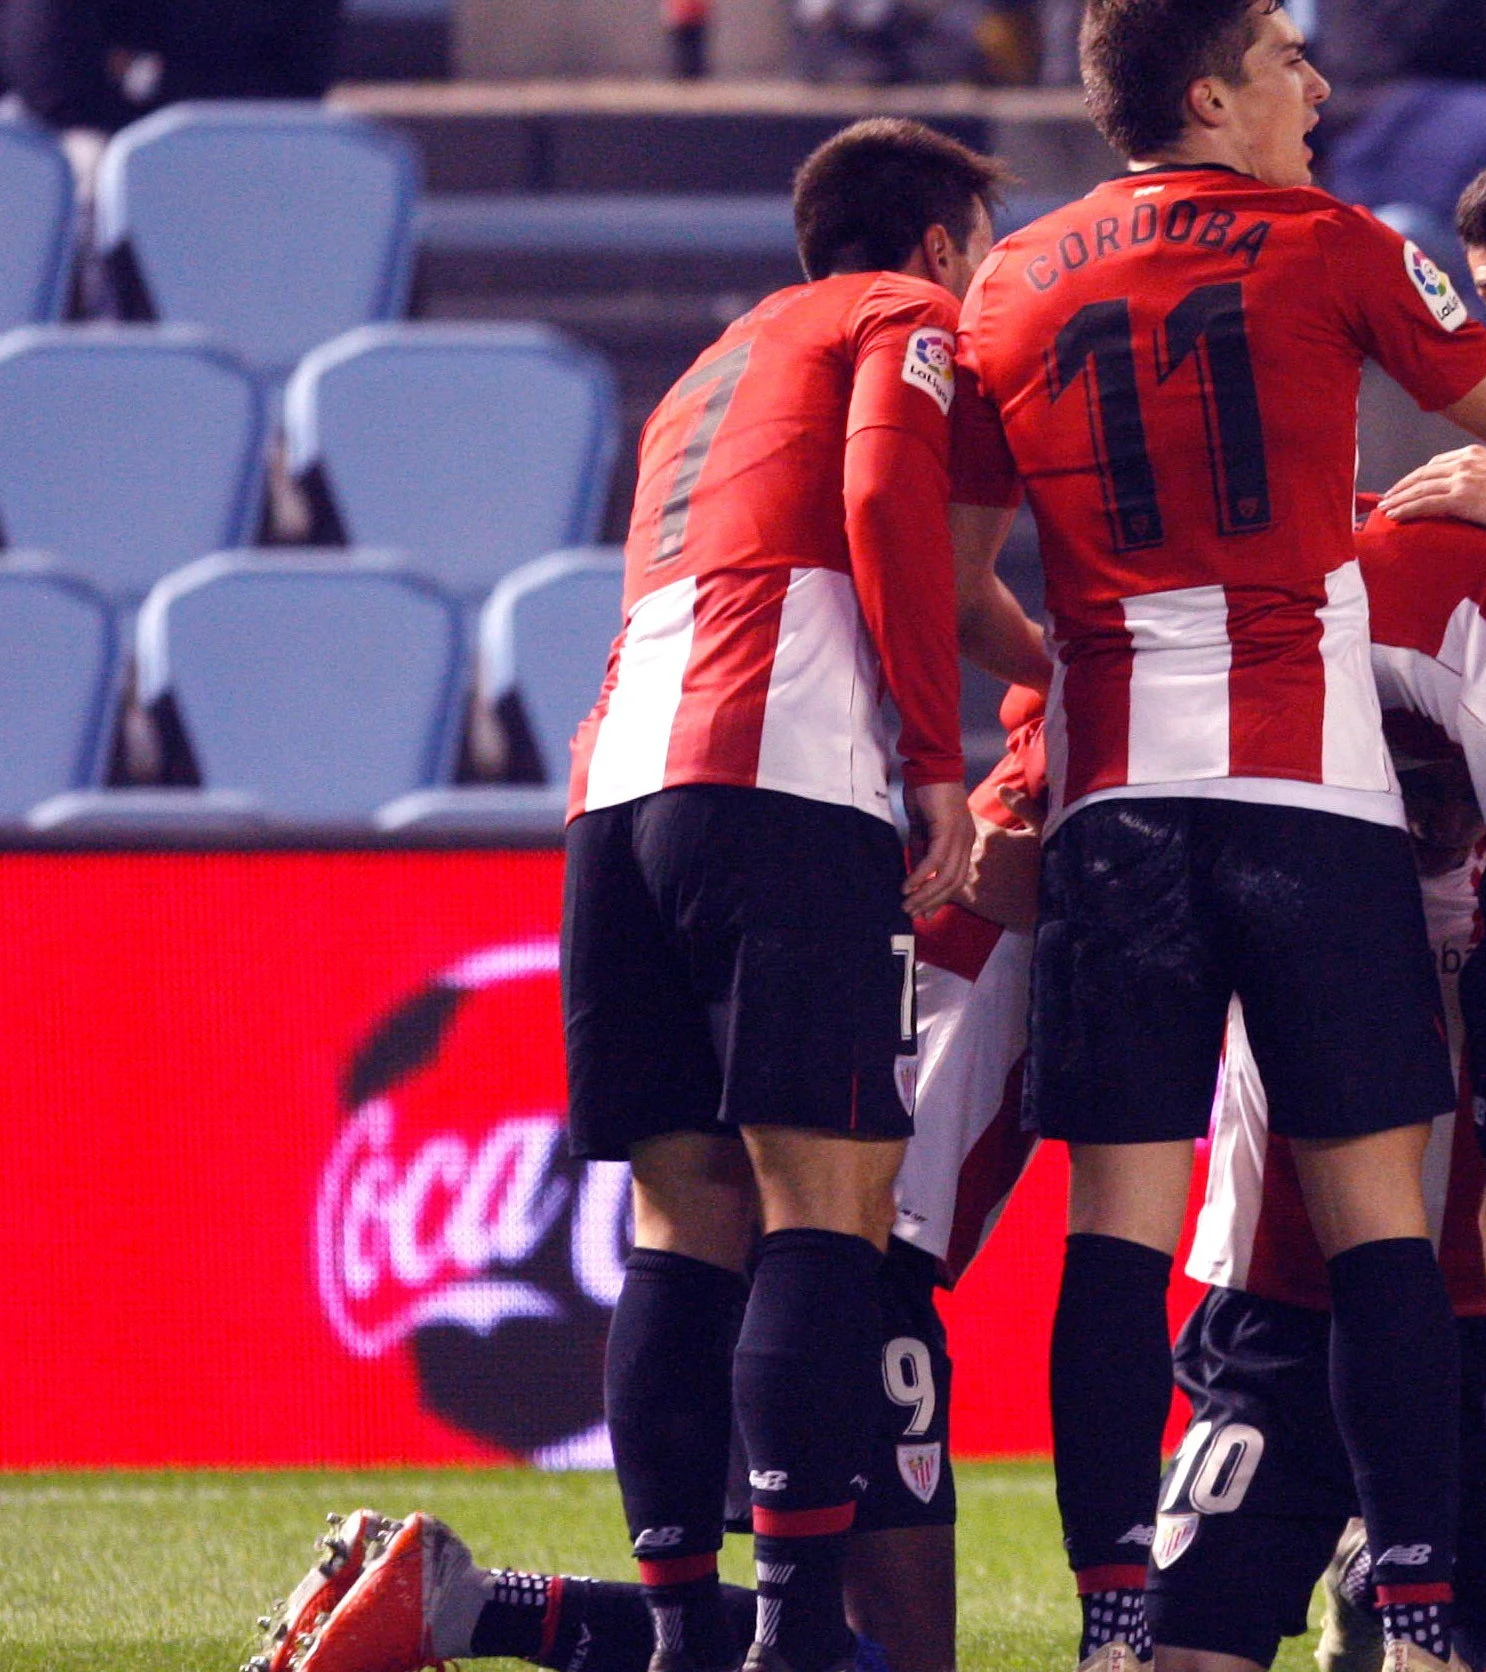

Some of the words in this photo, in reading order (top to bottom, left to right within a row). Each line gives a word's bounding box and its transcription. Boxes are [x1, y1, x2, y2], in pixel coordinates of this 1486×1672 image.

[1026, 200, 1272, 292] CORDOBA
[648, 340, 752, 575] 7
[1042, 281, 1272, 554] 11
[881, 1336, 936, 1435] 9
[1159, 1420, 1265, 1515] 10
